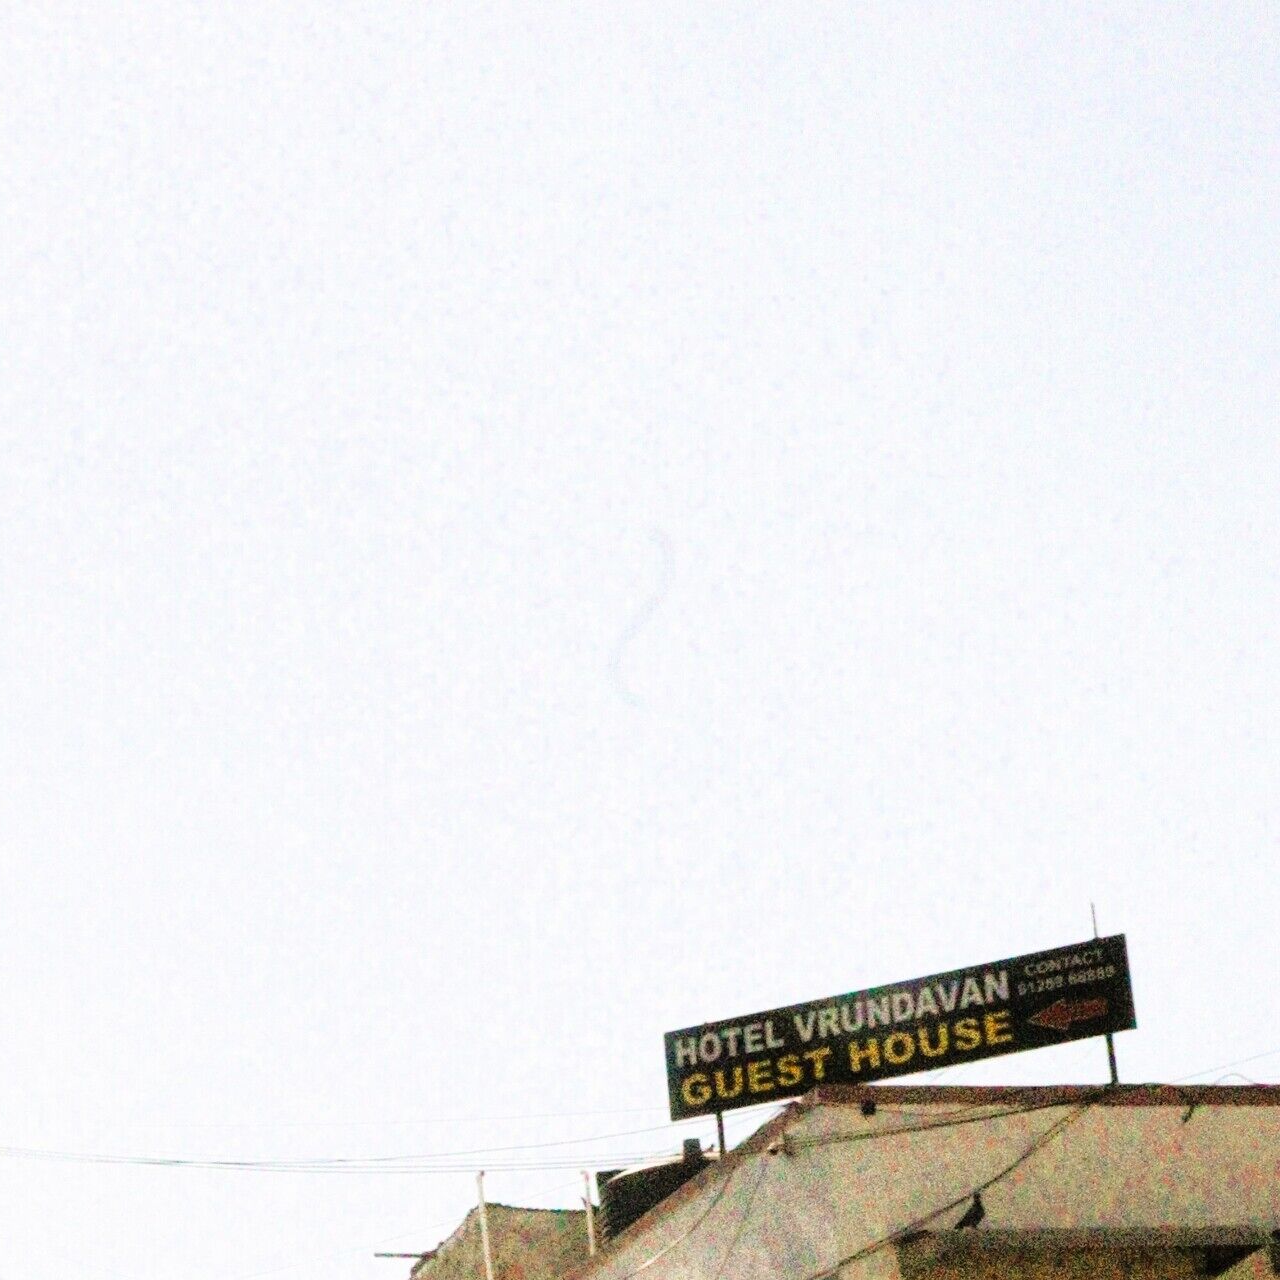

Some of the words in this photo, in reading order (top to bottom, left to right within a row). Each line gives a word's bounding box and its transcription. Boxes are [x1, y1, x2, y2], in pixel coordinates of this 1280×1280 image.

[1024, 949, 1103, 976] CONTACT
[675, 1023, 784, 1068] HOTEL
[793, 971, 1009, 1043] VRUNDAVAN
[682, 1047, 831, 1107] GUEST
[849, 1012, 1013, 1073] HOUSE
